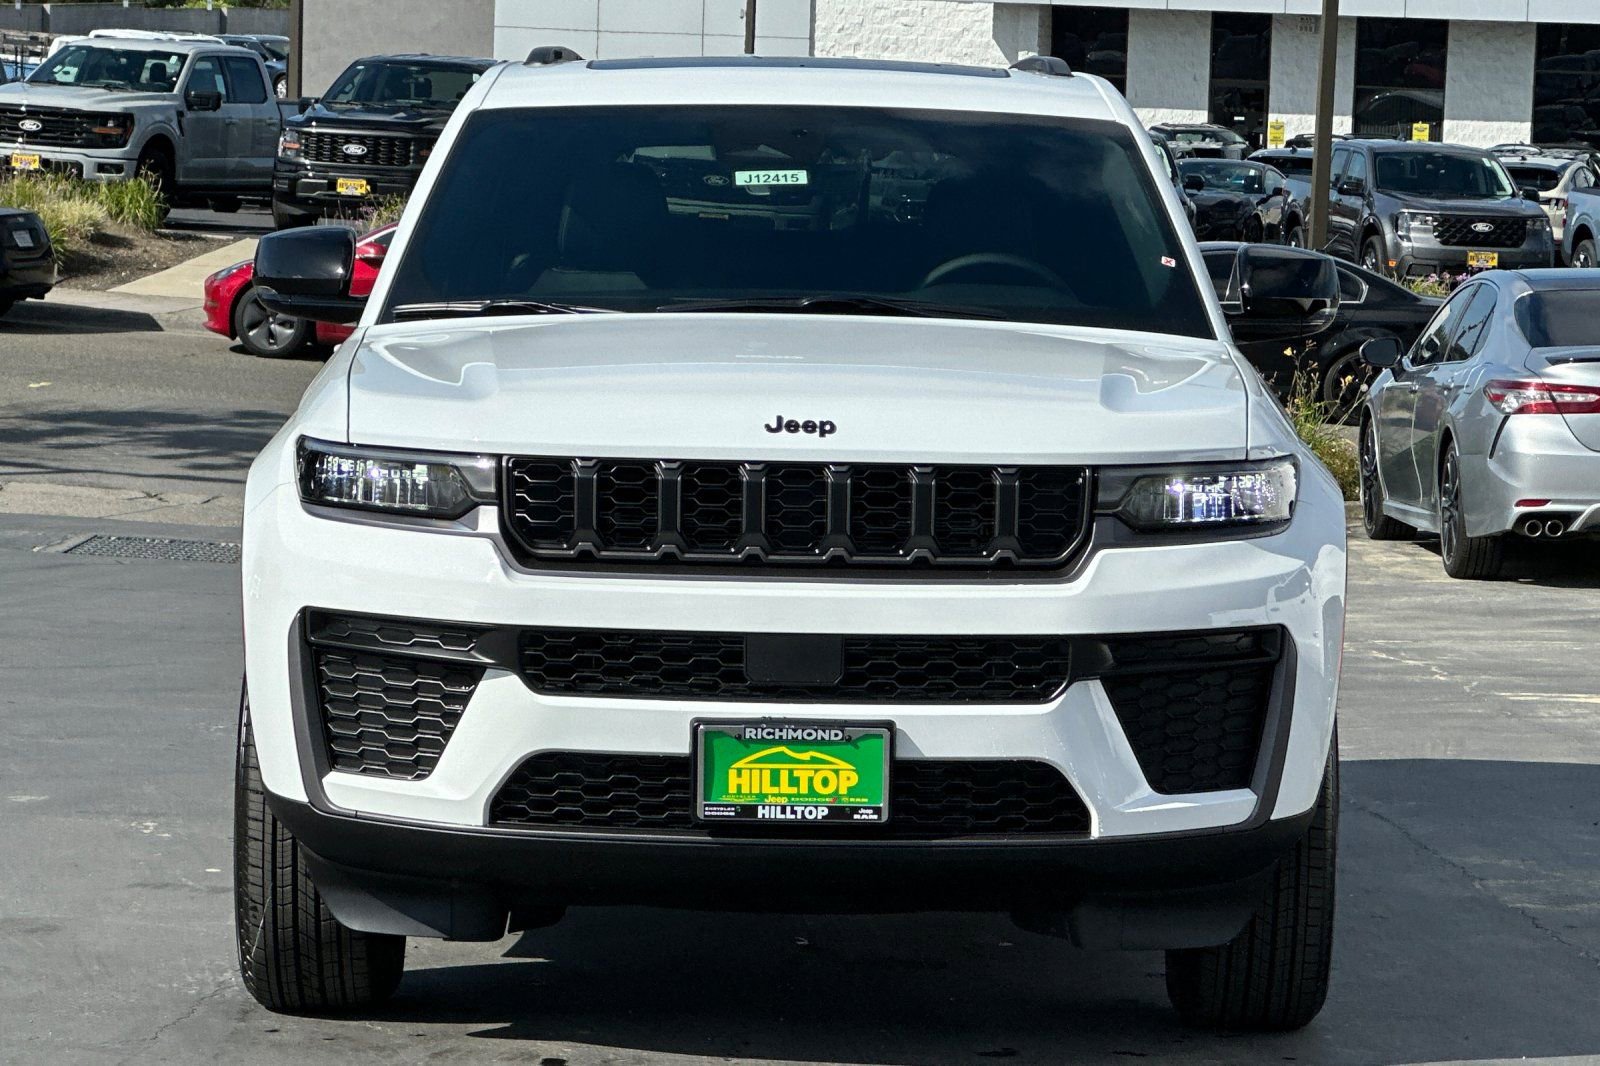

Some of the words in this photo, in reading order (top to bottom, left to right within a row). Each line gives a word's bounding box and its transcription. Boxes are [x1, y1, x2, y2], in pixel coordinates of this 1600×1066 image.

[744, 173, 799, 184] J12415
[764, 415, 837, 438] Jeep
[745, 728, 843, 741] RICHMOND
[728, 768, 859, 795] HILLTOP
[764, 794, 789, 804] Jeep
[757, 805, 829, 819] HILLTOP
